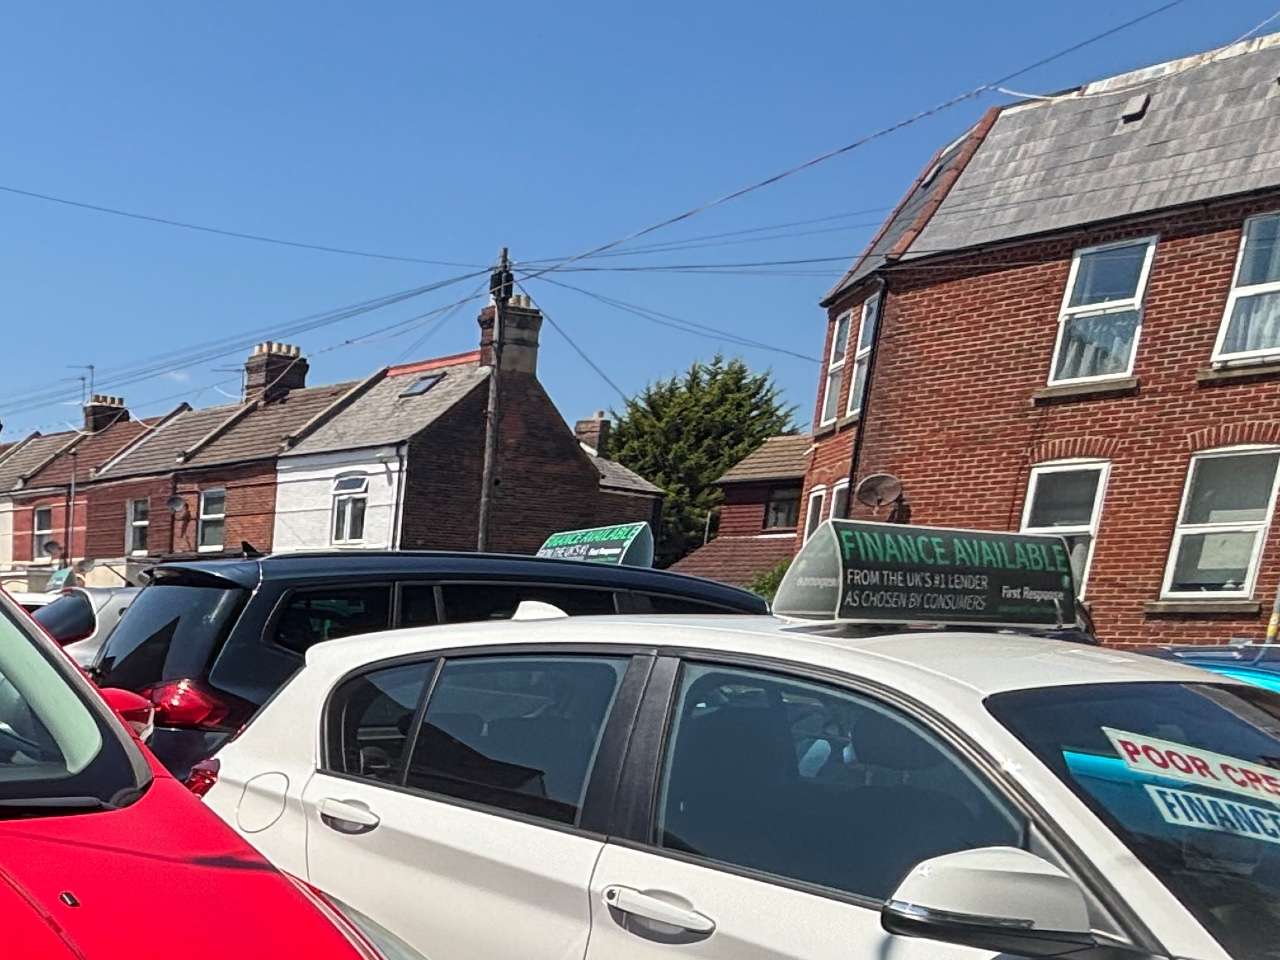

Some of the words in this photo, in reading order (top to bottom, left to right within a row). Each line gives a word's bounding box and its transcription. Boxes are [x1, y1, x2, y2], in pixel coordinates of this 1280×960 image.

[840, 530, 951, 566] FINANCE
[953, 538, 1069, 572] AVAILABLE
[847, 569, 881, 586] FROM
[882, 571, 905, 587] THE
[907, 572, 932, 588] UK'S
[933, 573, 946, 589] #1
[947, 574, 989, 590] LENDER
[844, 590, 862, 607] AS
[863, 591, 907, 608] CHOSEN
[907, 593, 922, 609] BY
[922, 594, 987, 611] CONSUMERS
[1001, 585, 1021, 600] First
[1022, 586, 1064, 603] Response
[1117, 739, 1220, 782] POOR
